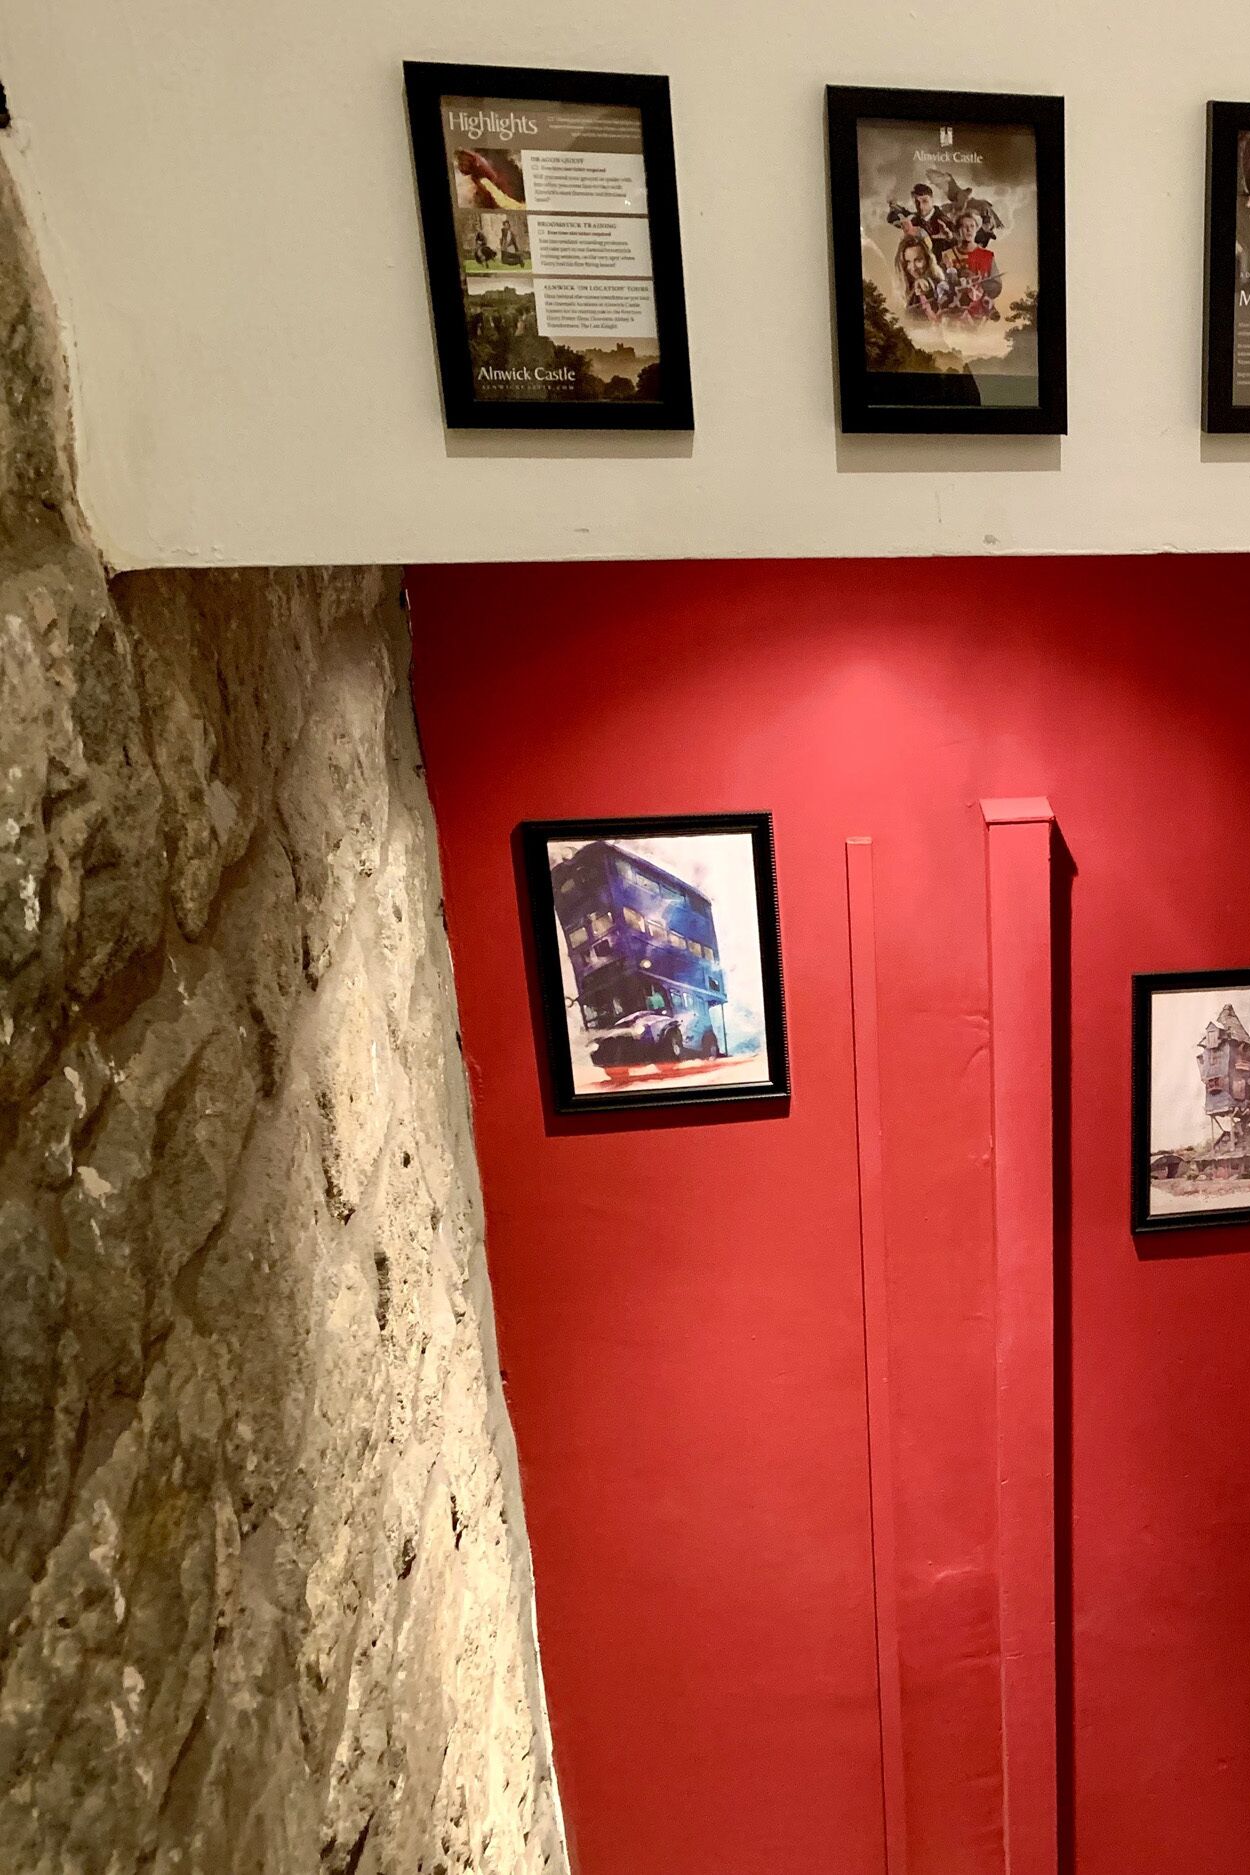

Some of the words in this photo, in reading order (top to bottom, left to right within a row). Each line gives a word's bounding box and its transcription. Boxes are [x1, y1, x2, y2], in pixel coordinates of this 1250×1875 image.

[449, 111, 538, 141] Highlights
[913, 150, 950, 162] Alnwick
[952, 151, 983, 163] Castle
[478, 366, 532, 381] Alnwick
[534, 366, 576, 381] Castle
